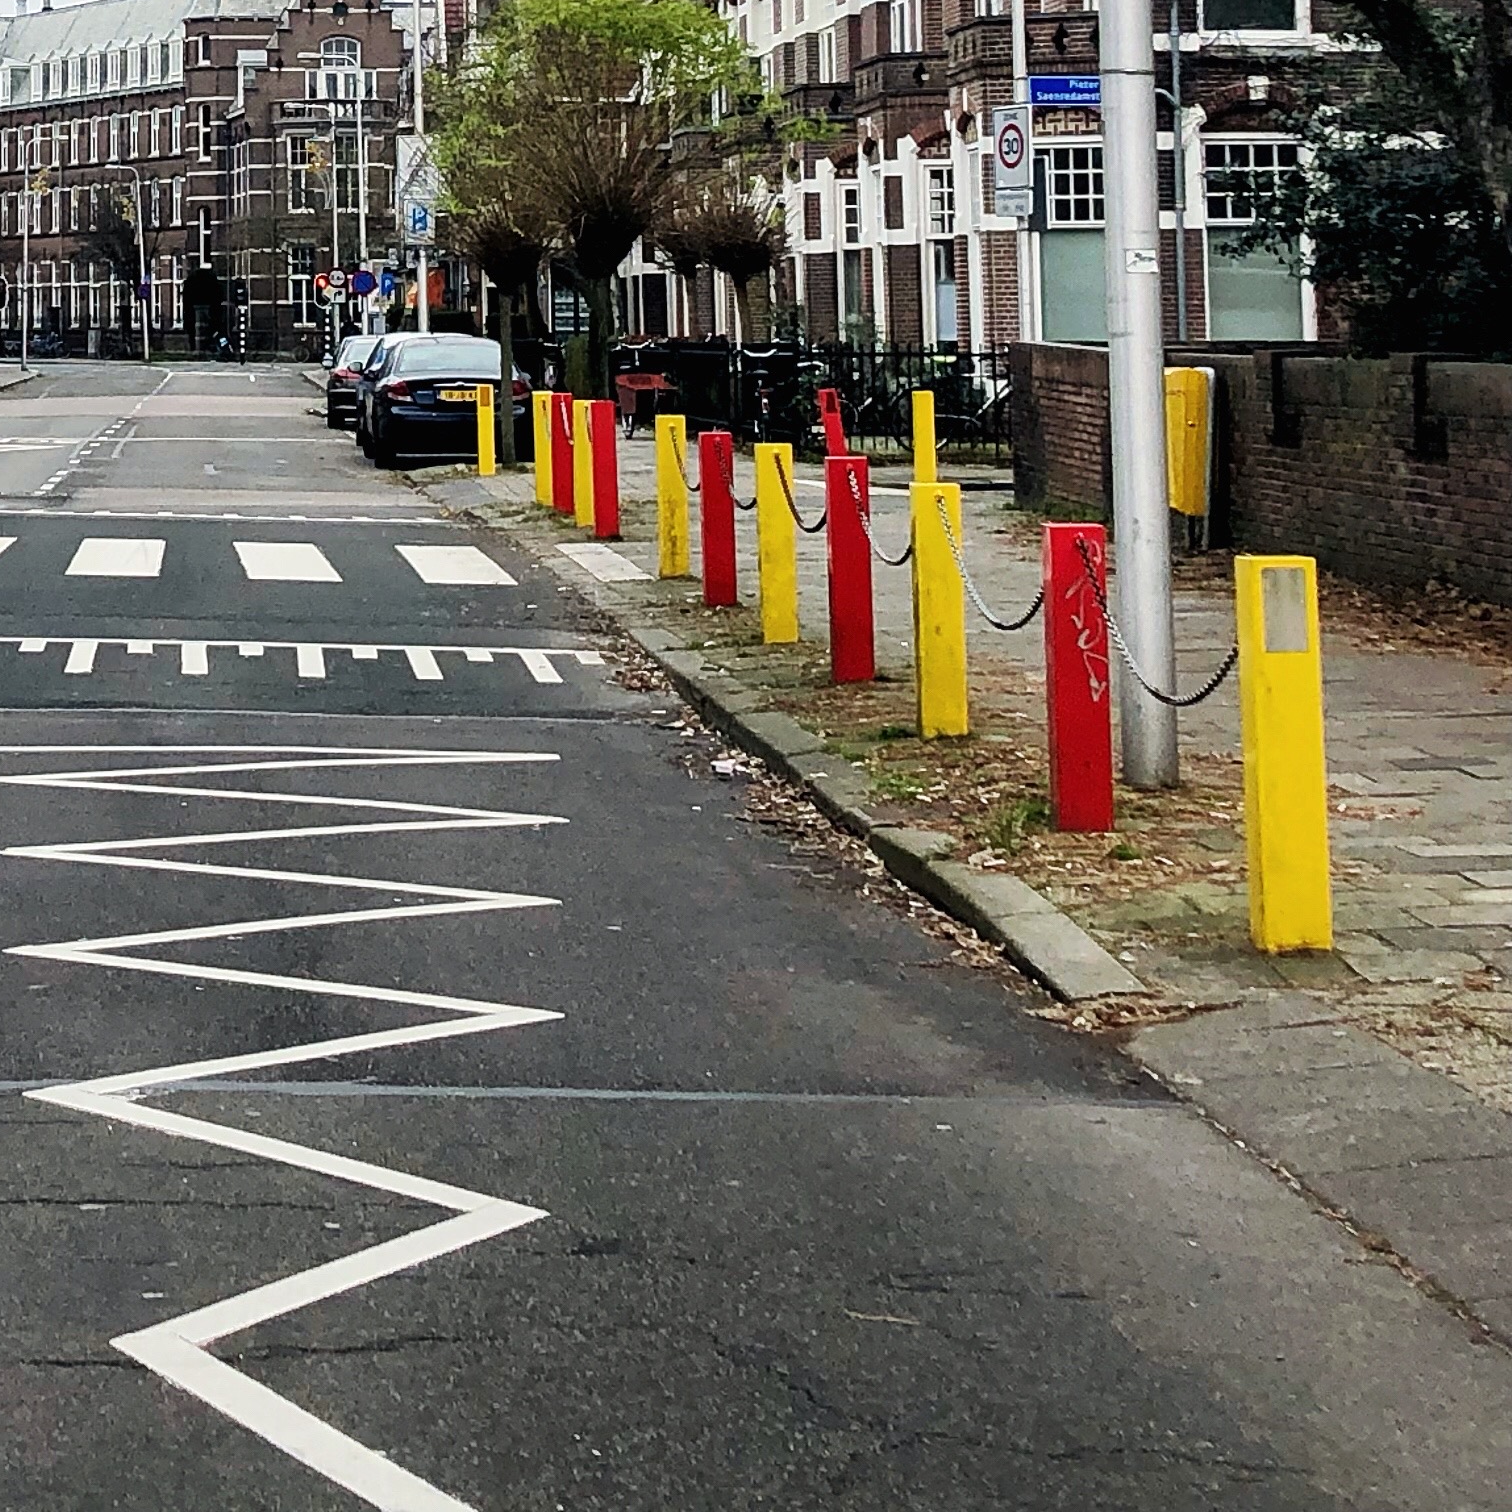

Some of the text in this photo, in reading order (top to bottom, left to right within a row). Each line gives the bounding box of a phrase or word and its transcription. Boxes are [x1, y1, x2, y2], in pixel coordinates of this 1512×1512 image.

[1069, 80, 1099, 89] Pieter
[1036, 91, 1100, 101] Saenredamst
[1003, 137, 1019, 155] 30
